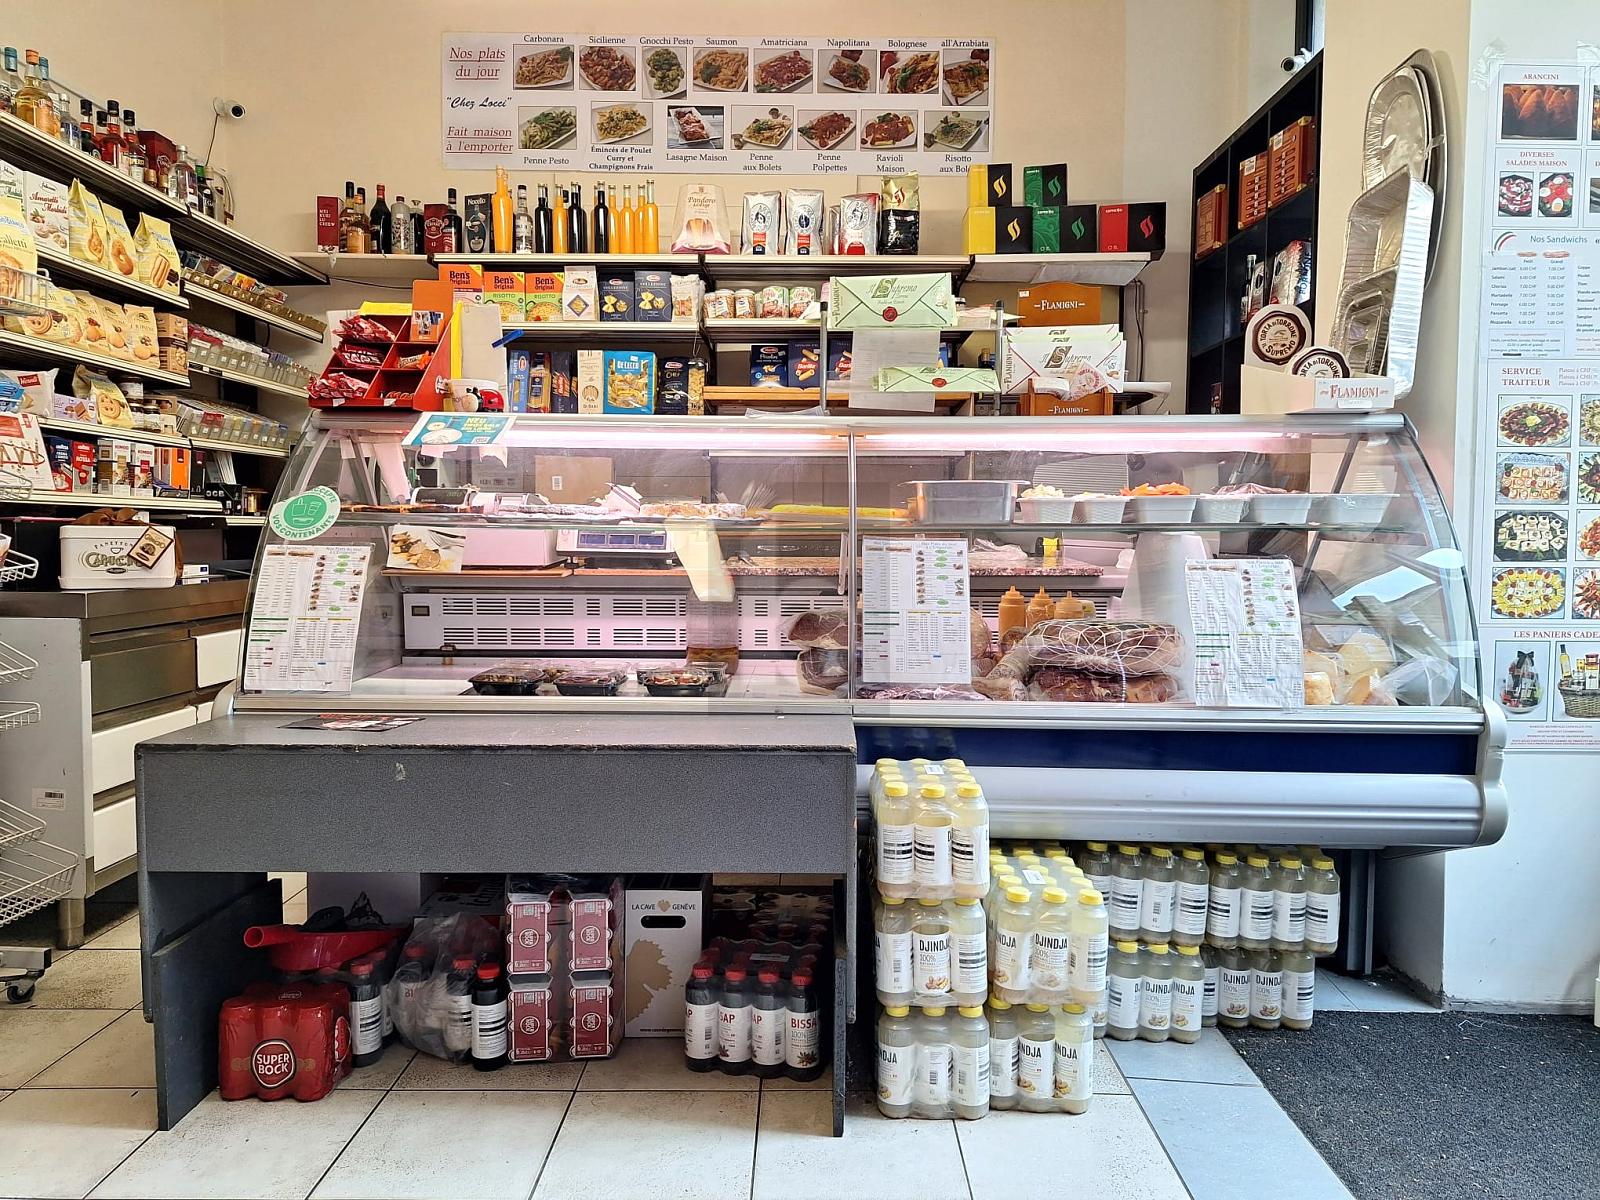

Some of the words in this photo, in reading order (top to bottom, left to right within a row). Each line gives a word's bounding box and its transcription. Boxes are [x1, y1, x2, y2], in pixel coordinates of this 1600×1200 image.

[523, 34, 565, 43] Carbonara
[588, 35, 626, 44] Sicilienne
[639, 36, 671, 45] Gnocchi
[673, 37, 694, 45] Pesto
[705, 38, 738, 46] Saumon
[760, 38, 808, 47] Amatriciana
[827, 39, 870, 48] Napolitana
[888, 39, 928, 49] Bolognese
[941, 39, 989, 48] all'Arrabiata
[449, 47, 473, 59] Nos
[478, 47, 506, 62] plats
[455, 66, 471, 77] du
[476, 66, 500, 80] jour
[447, 126, 468, 138] Fait
[473, 127, 512, 138] maison
[446, 142, 453, 152] à
[458, 141, 514, 155] l'emporter
[591, 144, 617, 154] Émincés
[618, 146, 628, 154] de
[629, 146, 652, 154] Poulet
[523, 156, 547, 165] Penne
[549, 157, 570, 165] Pesto
[606, 154, 626, 163] Curry
[666, 153, 697, 162] Lasagne
[699, 153, 728, 161] Maison
[750, 153, 774, 161] Penne
[817, 153, 841, 161] Penne
[876, 154, 904, 162] Ravioli
[945, 154, 972, 162] Risotto
[588, 162, 635, 172] Champignons
[758, 163, 782, 171] Bolets
[1506, 159, 1538, 167] SALADES
[812, 163, 848, 173] Polpettes
[876, 164, 905, 173] Maison
[955, 165, 970, 173] Bol
[29, 192, 59, 204] Amaretti
[1530, 235, 1545, 243] Nos
[1546, 235, 1588, 243] Sandwichs
[449, 270, 470, 279] Ben's
[494, 275, 514, 284] Ben's
[535, 276, 555, 285] Ben's
[1041, 300, 1079, 310] FLAMIGNI
[1260, 323, 1273, 341] TORTA
[1276, 318, 1297, 338] TORRONE
[1300, 362, 1313, 377] ORTA
[1501, 367, 1542, 375] SERVICE
[1502, 378, 1551, 386] TRAITEUR
[1329, 384, 1379, 399] FLAMIGNI
[1053, 405, 1085, 415] FLAMIGNI
[272, 514, 283, 529] VOS
[279, 514, 335, 538] CONTENANTS
[1513, 630, 1531, 638] LES
[1533, 631, 1572, 639] PANIERS
[631, 903, 640, 911] LA
[640, 903, 656, 911] CAVE
[1035, 933, 1068, 949] DJINDJA
[920, 952, 937, 963] 100%
[720, 1013, 736, 1024] SAP
[791, 1017, 817, 1029] BISSA
[1021, 1043, 1042, 1059] NDJA
[1055, 1042, 1078, 1060] NDJA
[256, 1053, 290, 1065] SUPER
[879, 1050, 898, 1065] NDJA
[258, 1063, 289, 1075] BOCK
